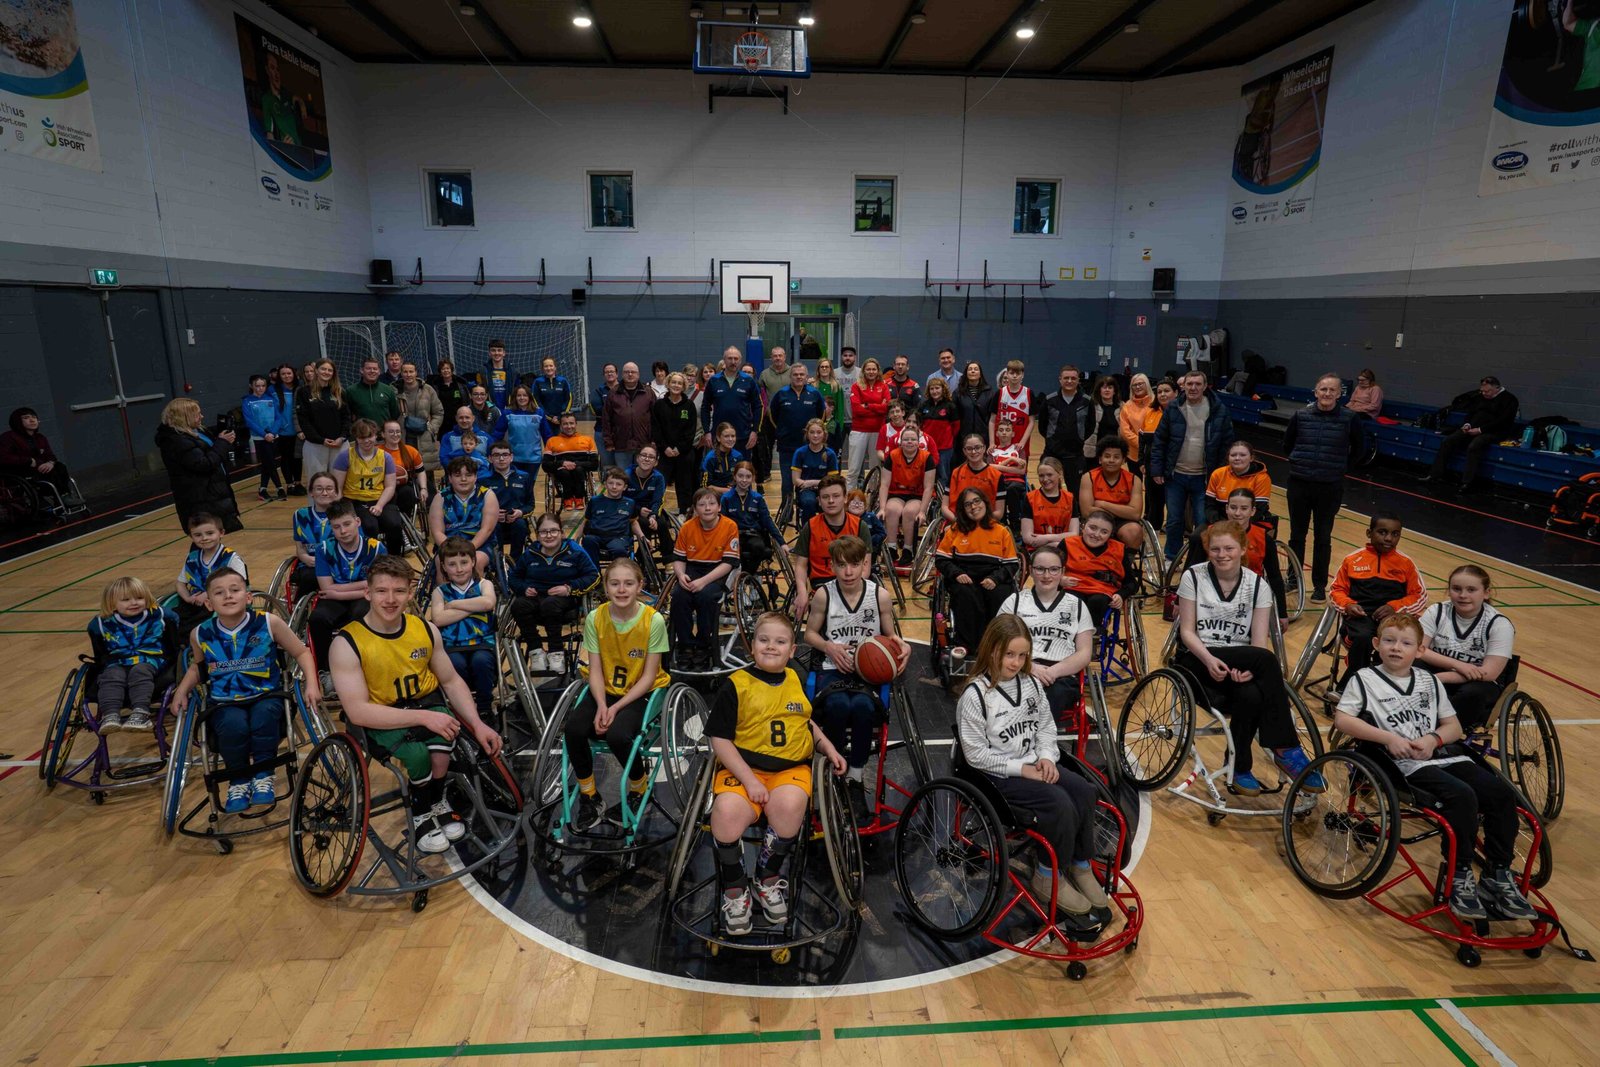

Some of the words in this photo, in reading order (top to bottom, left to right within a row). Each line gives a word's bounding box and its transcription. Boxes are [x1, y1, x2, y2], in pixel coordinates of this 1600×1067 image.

[1283, 55, 1330, 83] Wheelchair
[1283, 71, 1328, 98] basketball
[59, 137, 86, 152] SPORT
[1000, 411, 1017, 422] HC
[359, 477, 374, 490] 14
[831, 625, 875, 640] SWIFTS
[1029, 626, 1071, 641] WIFTS
[1196, 619, 1247, 636] SWIFTS
[1041, 638, 1053, 653] 7
[612, 665, 628, 689] 6
[393, 673, 421, 700] 10
[1386, 709, 1432, 729] SWIFTS
[770, 720, 787, 748] 8
[998, 720, 1040, 744] SWIFTS
